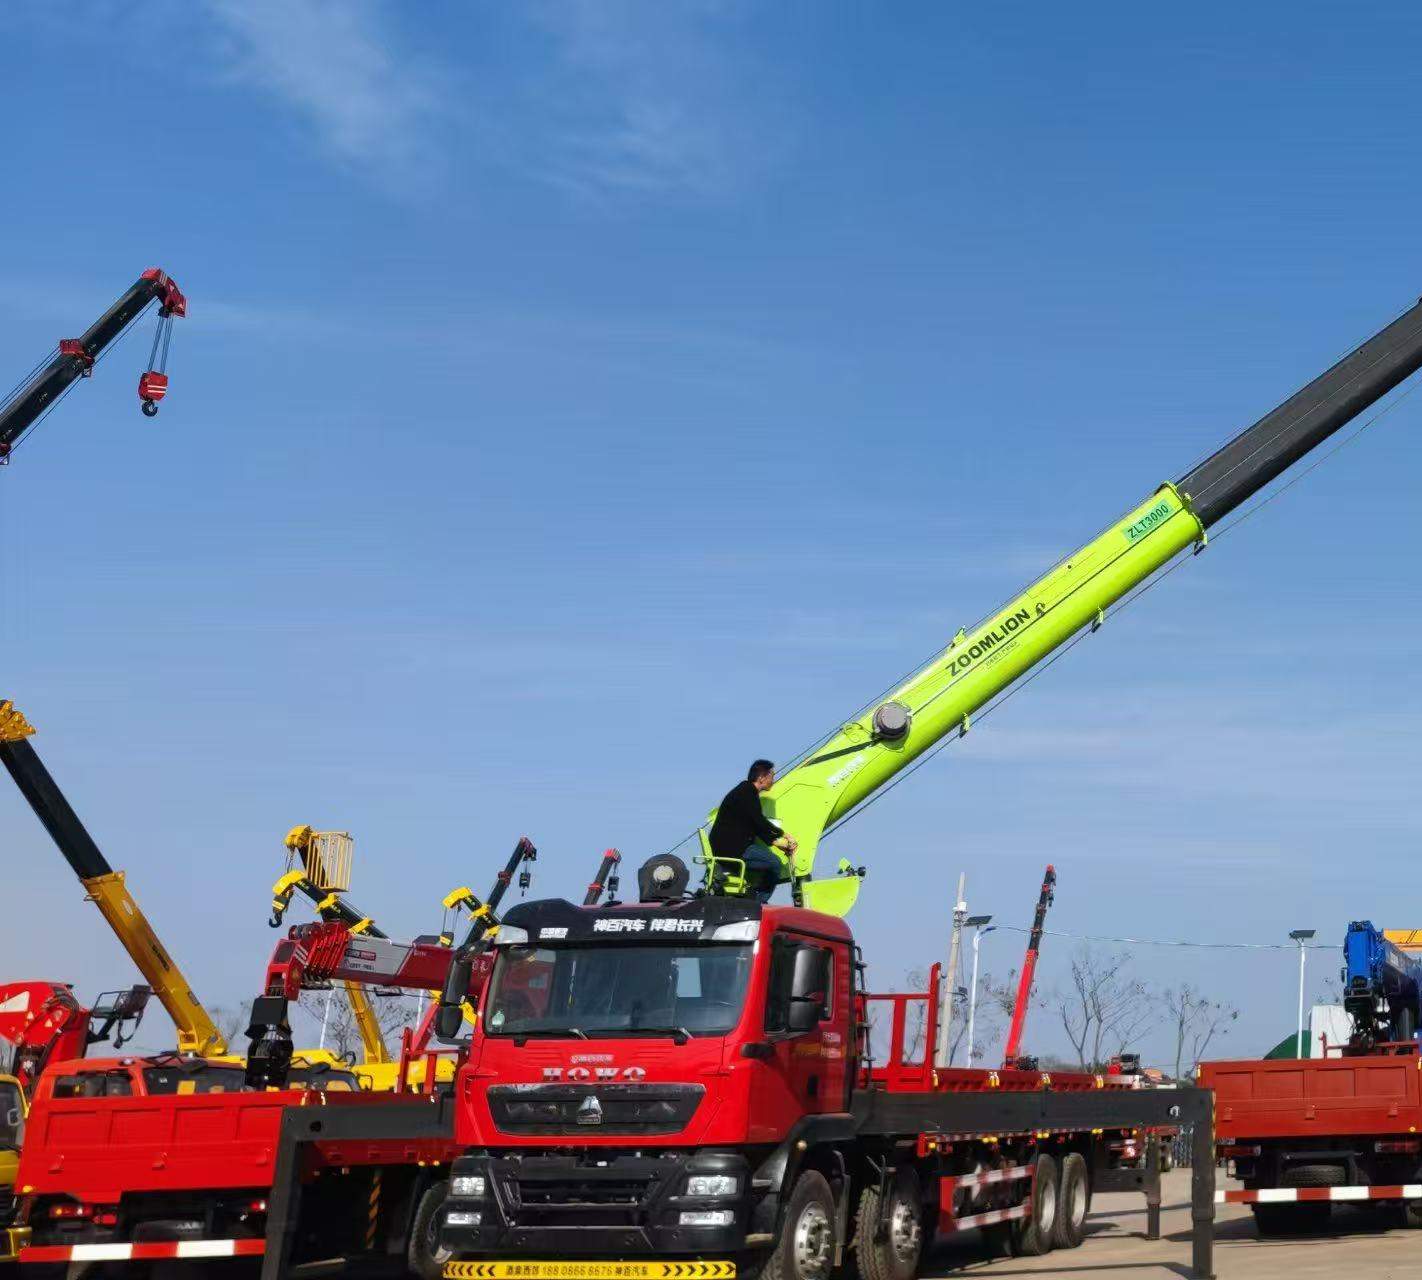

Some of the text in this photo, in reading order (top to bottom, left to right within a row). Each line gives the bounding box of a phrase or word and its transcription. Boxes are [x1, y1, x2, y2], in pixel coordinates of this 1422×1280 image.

[1127, 503, 1169, 540] ZLT3000
[946, 608, 1031, 677] ZOOMLION
[593, 918, 646, 932] 神百汽车
[542, 1066, 647, 1081] HOWO
